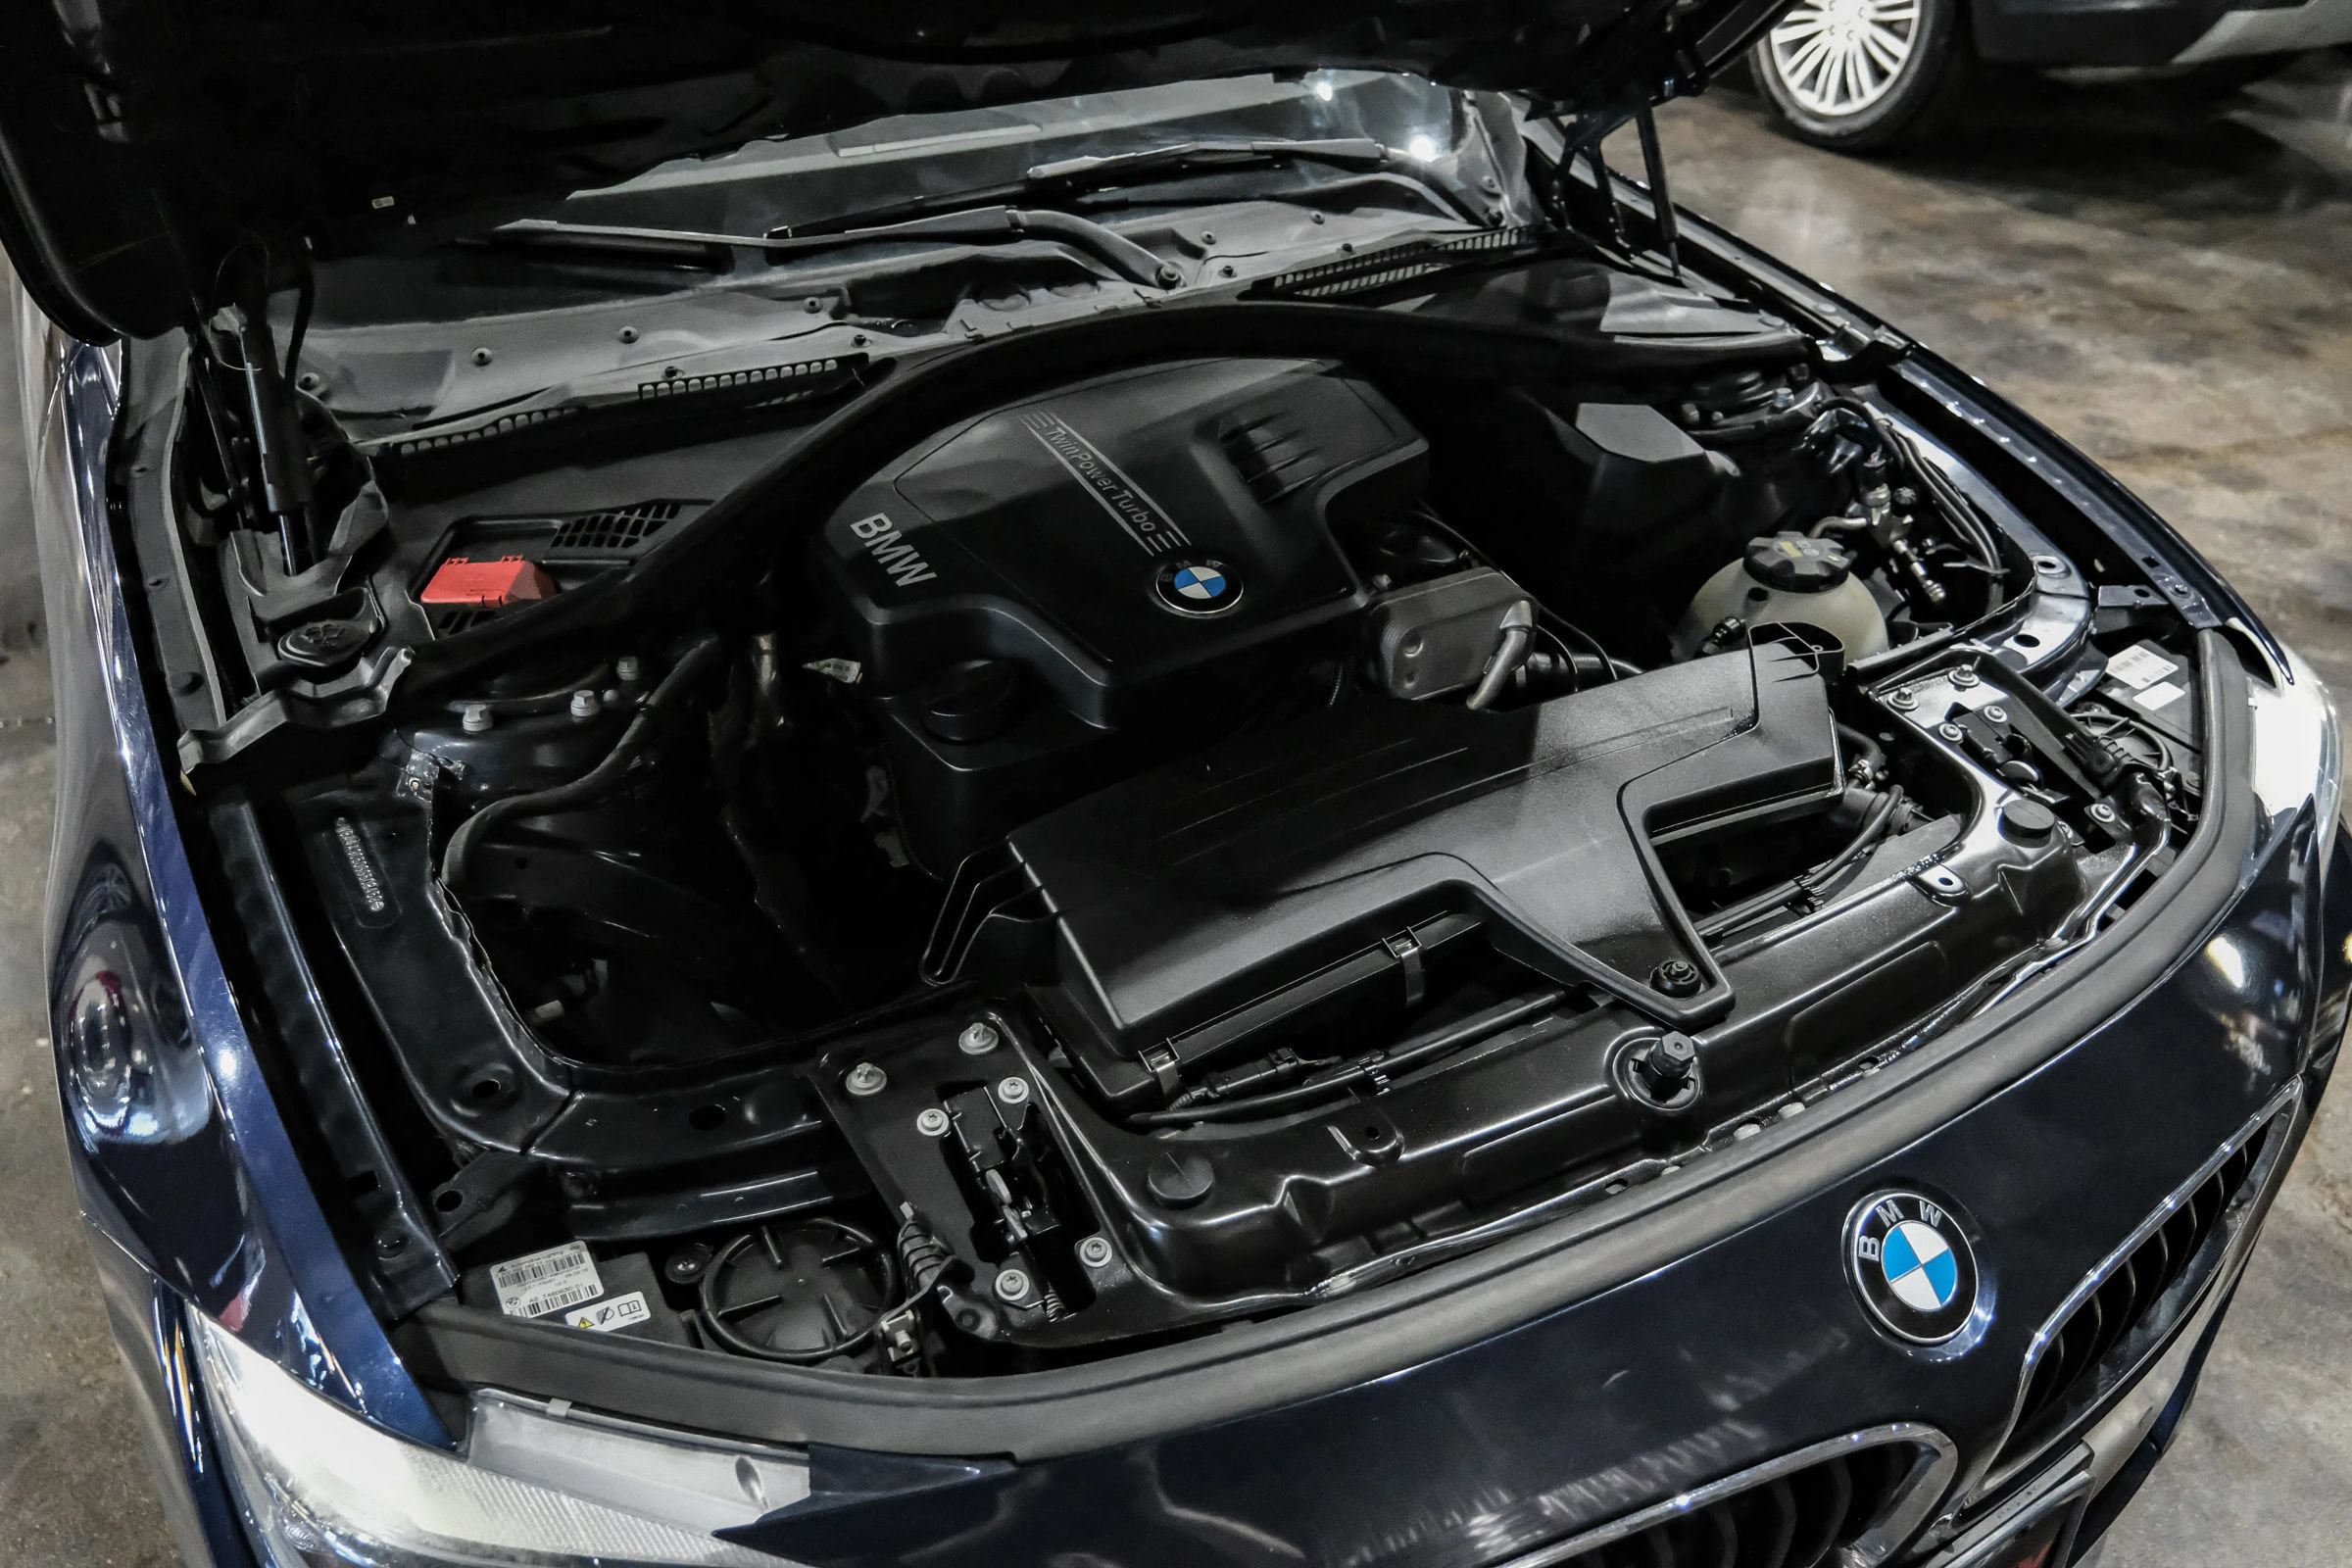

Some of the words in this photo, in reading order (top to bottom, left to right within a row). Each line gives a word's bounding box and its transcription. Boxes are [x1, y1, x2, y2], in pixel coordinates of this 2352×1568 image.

[1047, 426, 1118, 491] TwinPower
[1111, 490, 1156, 532] Turbo
[850, 513, 938, 587] BMW
[1857, 1199, 1942, 1262] BMW
